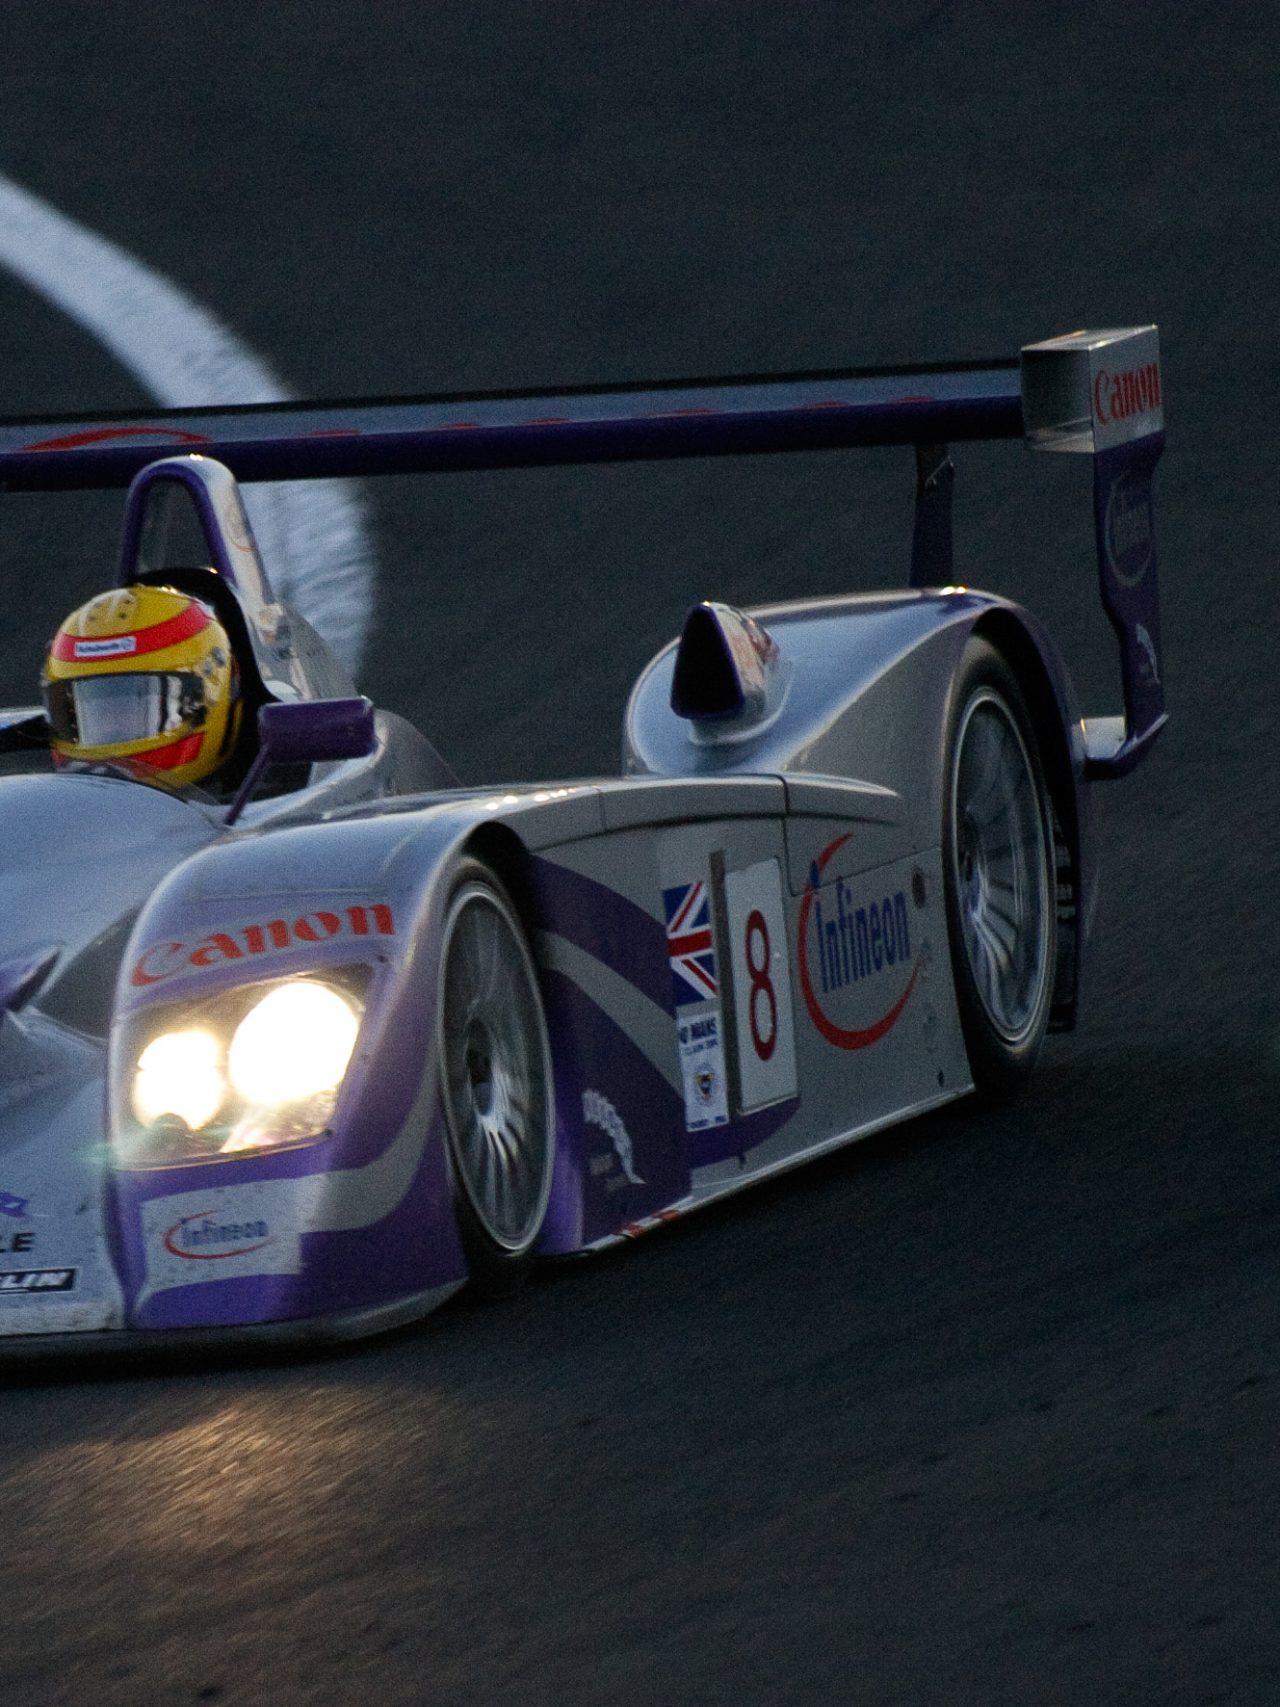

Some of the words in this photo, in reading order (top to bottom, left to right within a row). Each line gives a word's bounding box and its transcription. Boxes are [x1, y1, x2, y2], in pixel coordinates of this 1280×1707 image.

[1094, 362, 1160, 425] Canon
[131, 903, 395, 986] Canon
[745, 910, 777, 1061] 8
